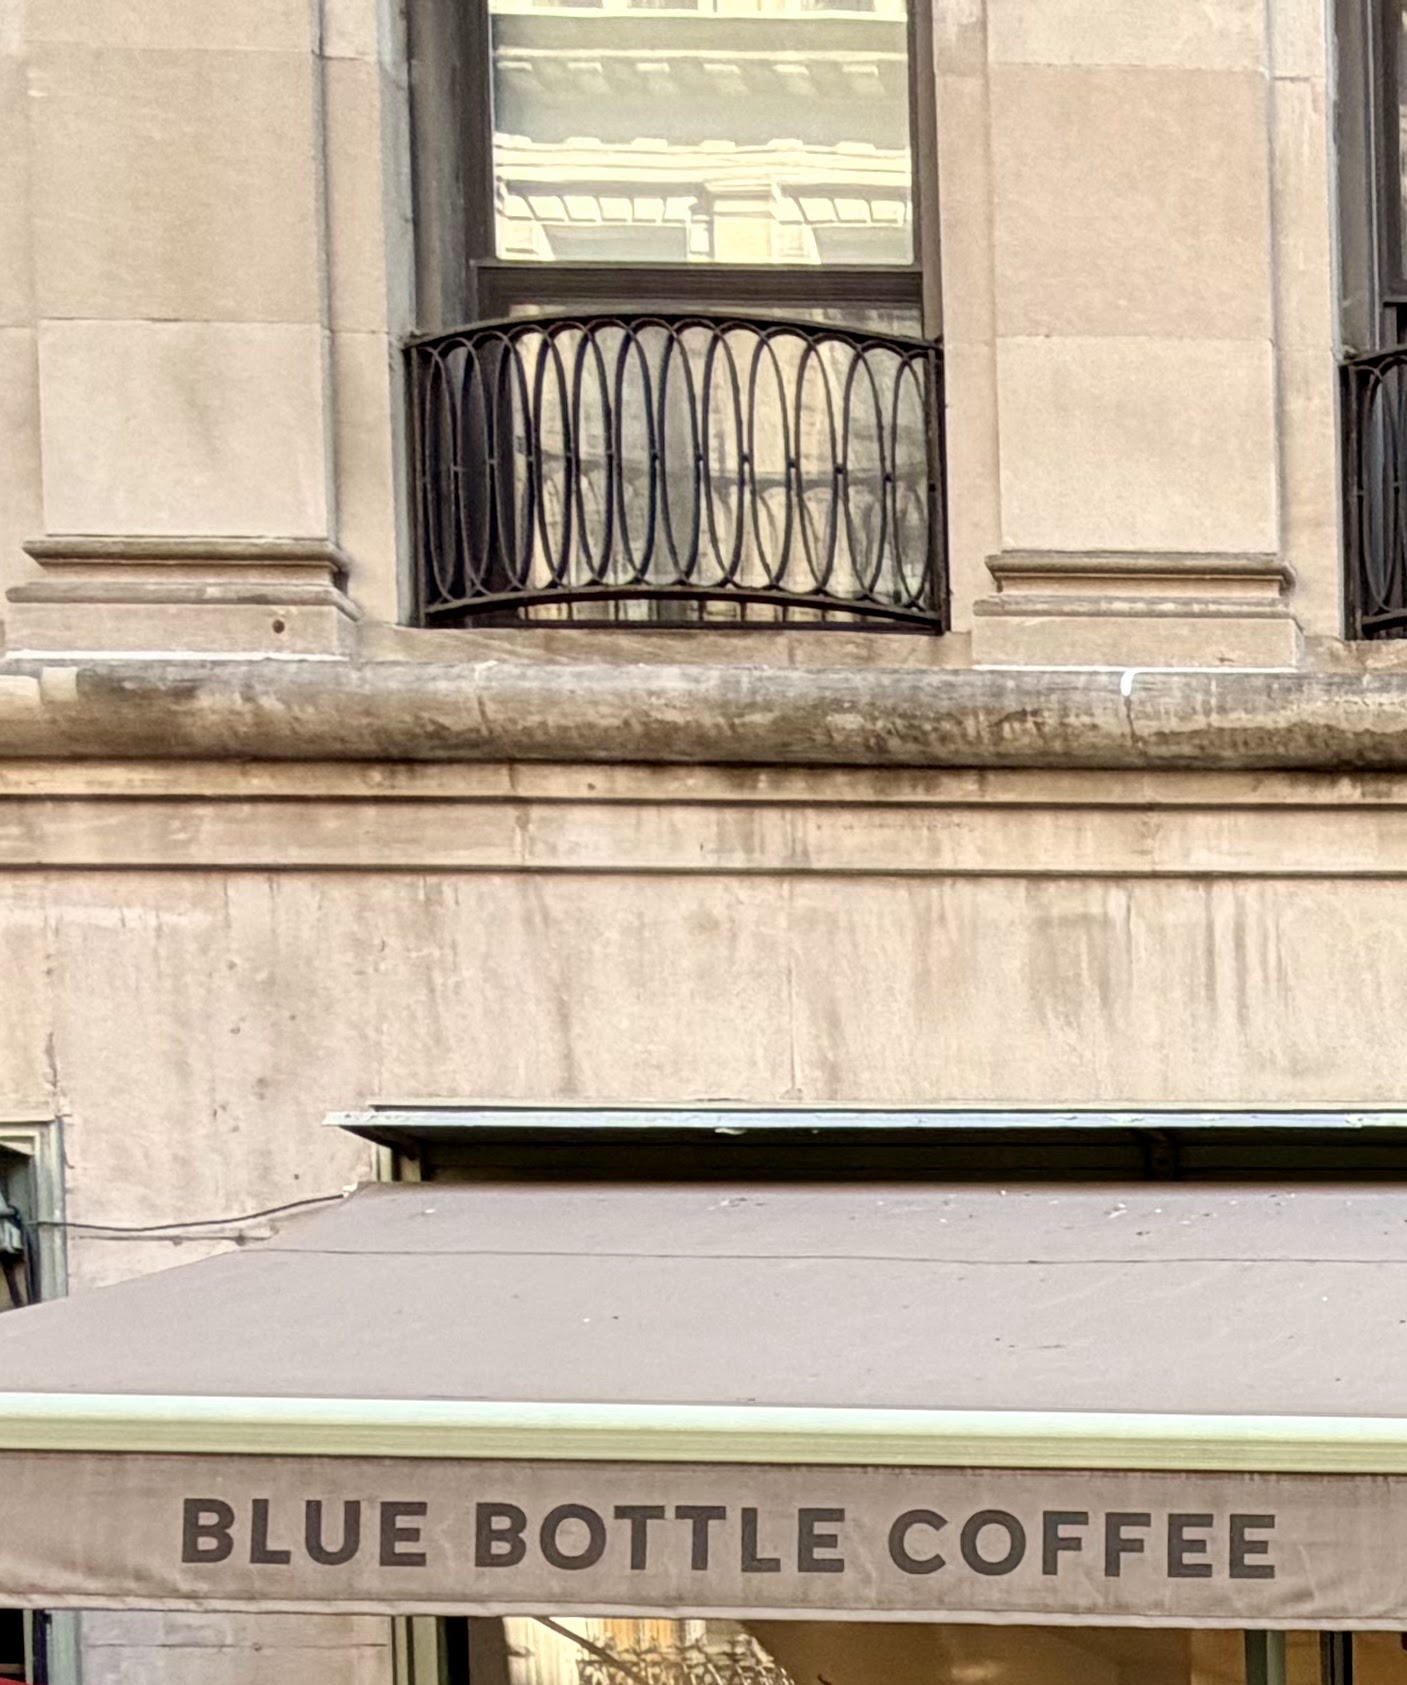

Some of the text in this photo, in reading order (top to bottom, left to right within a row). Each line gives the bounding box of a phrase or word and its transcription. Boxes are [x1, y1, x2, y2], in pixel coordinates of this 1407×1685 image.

[181, 1497, 1276, 1580] BLUE BOTTLE COFFEE
